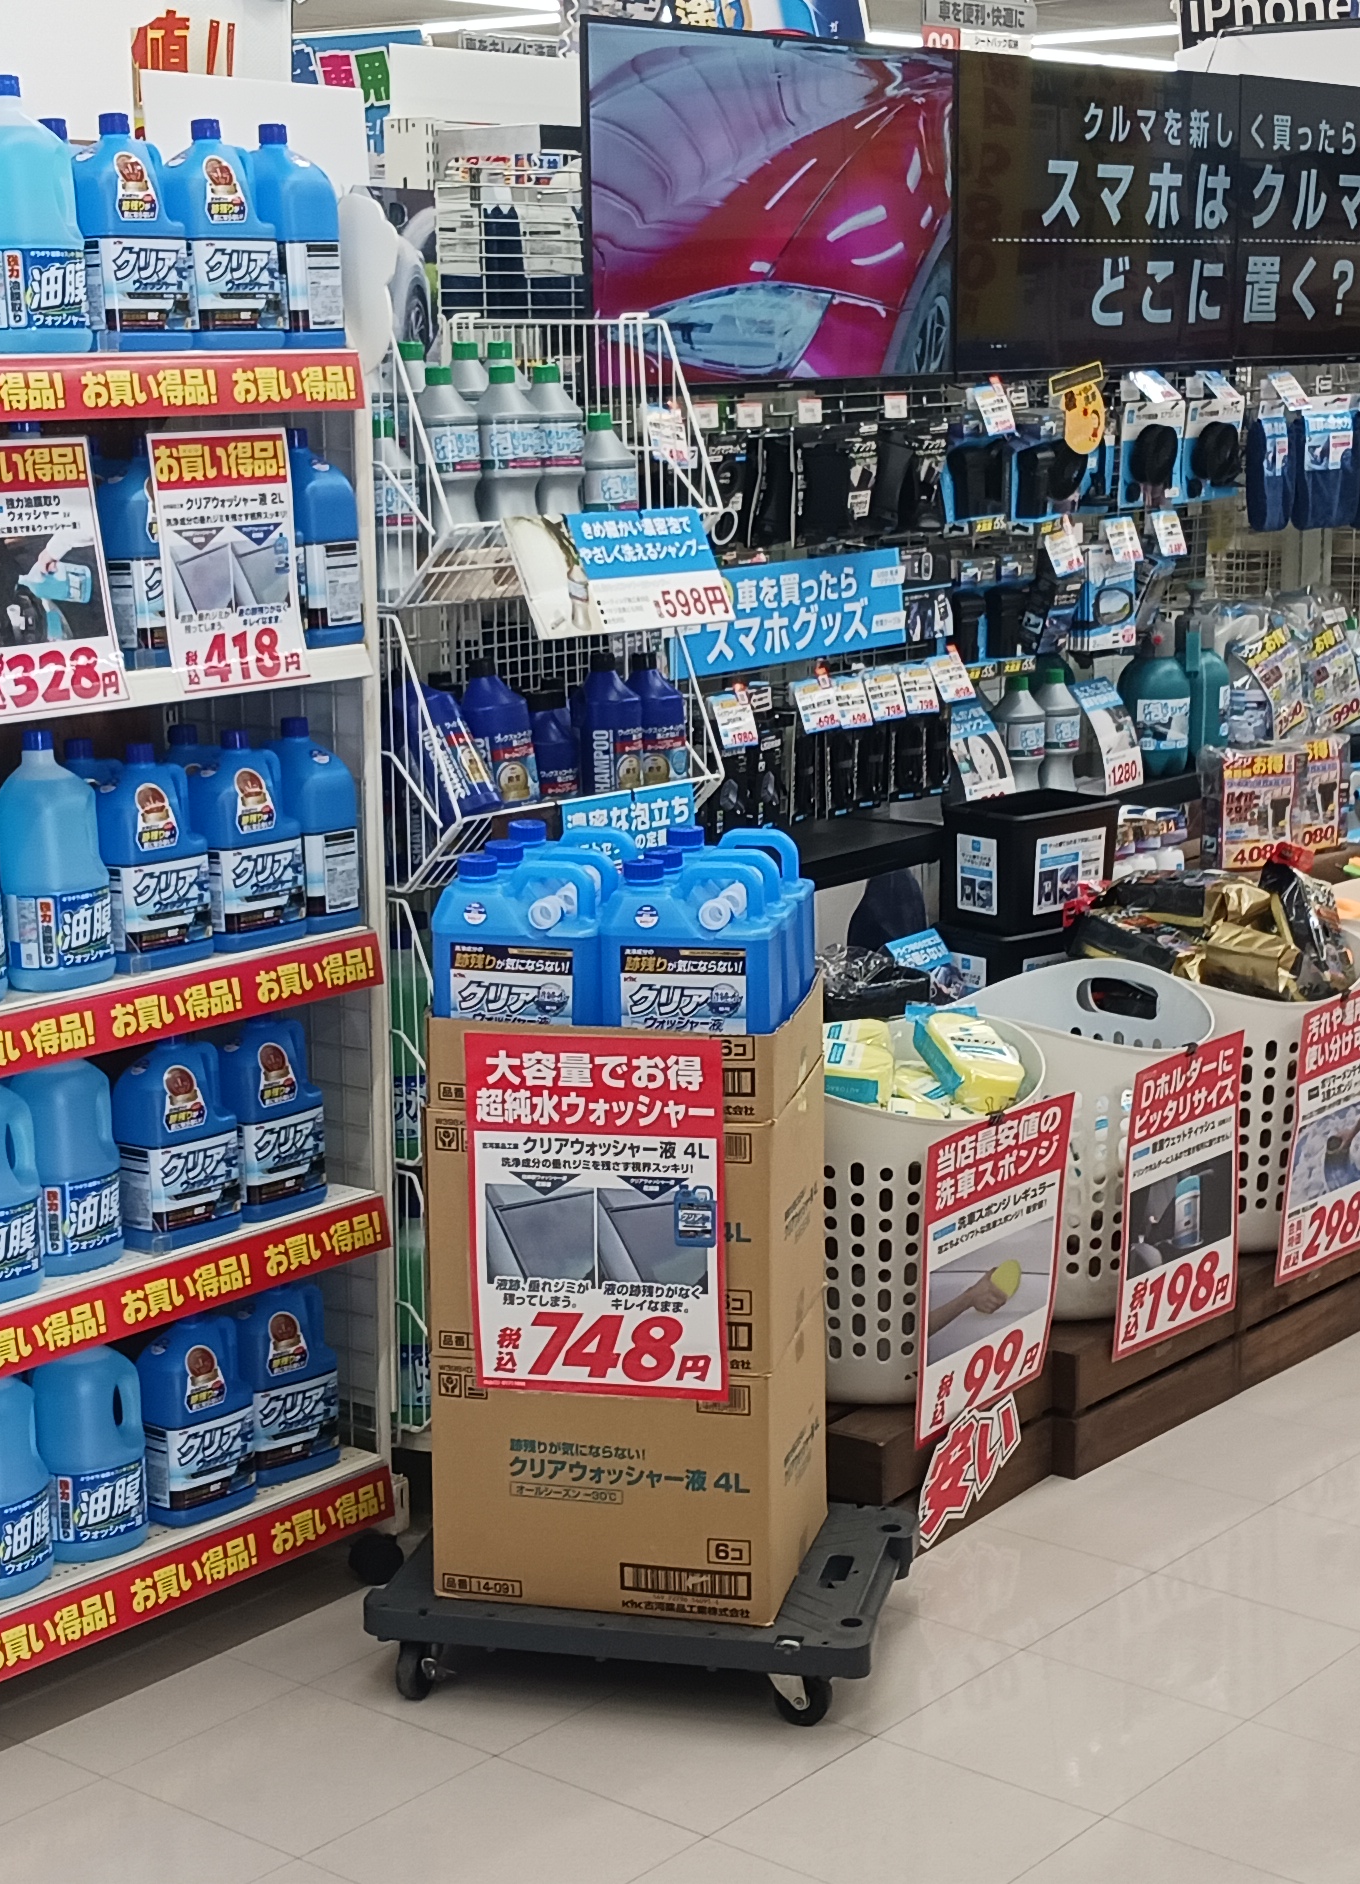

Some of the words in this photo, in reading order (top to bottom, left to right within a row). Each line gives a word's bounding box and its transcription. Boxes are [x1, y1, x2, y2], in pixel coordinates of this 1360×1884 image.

[1188, 0, 1352, 33] iPhone
[1083, 102, 1356, 155] クルマを新しく買ったら
[113, 246, 180, 282] クリア
[205, 247, 270, 283] クリア
[30, 262, 87, 312] 油膜
[7, 511, 60, 522] ウォッシャー
[186, 493, 268, 510] クリアウォッシャー液
[271, 492, 285, 504] 2L
[579, 543, 710, 565] やさしく洗えるシャンプー
[737, 568, 858, 613] 車を買ったら
[706, 598, 869, 665] スマホグッズ
[133, 863, 198, 905] クリア
[233, 848, 294, 889] クリア
[60, 901, 112, 953] 油膜
[457, 981, 541, 1014] クリア
[629, 983, 711, 1017] クリア
[486, 1050, 704, 1092] 大容量でお得
[1142, 1048, 1233, 1109] Dホルダーに
[476, 1088, 716, 1129] 超純水ウォッシャー
[1135, 1076, 1235, 1140] ピッタリサイズ
[255, 1125, 314, 1162] クリア
[522, 1136, 677, 1160] クリアウォッシャー液
[684, 1142, 710, 1160] 4L
[937, 1105, 1062, 1178] 当店最安値の
[160, 1143, 225, 1184] クリア
[935, 1134, 1059, 1212] 洗車スポンジ
[65, 1183, 121, 1241] 油膜
[603, 1283, 701, 1300] 液の跡残りがなく
[495, 1326, 522, 1374] 税込
[260, 1389, 323, 1430] クリア
[177, 1425, 242, 1468] クリア
[509, 1456, 707, 1493] クリアウォッシャー液
[713, 1472, 751, 1495] 4L
[515, 1484, 581, 1499] オールシーズン
[75, 1474, 141, 1529] 油膜
[475, 1579, 518, 1595] 14-091
